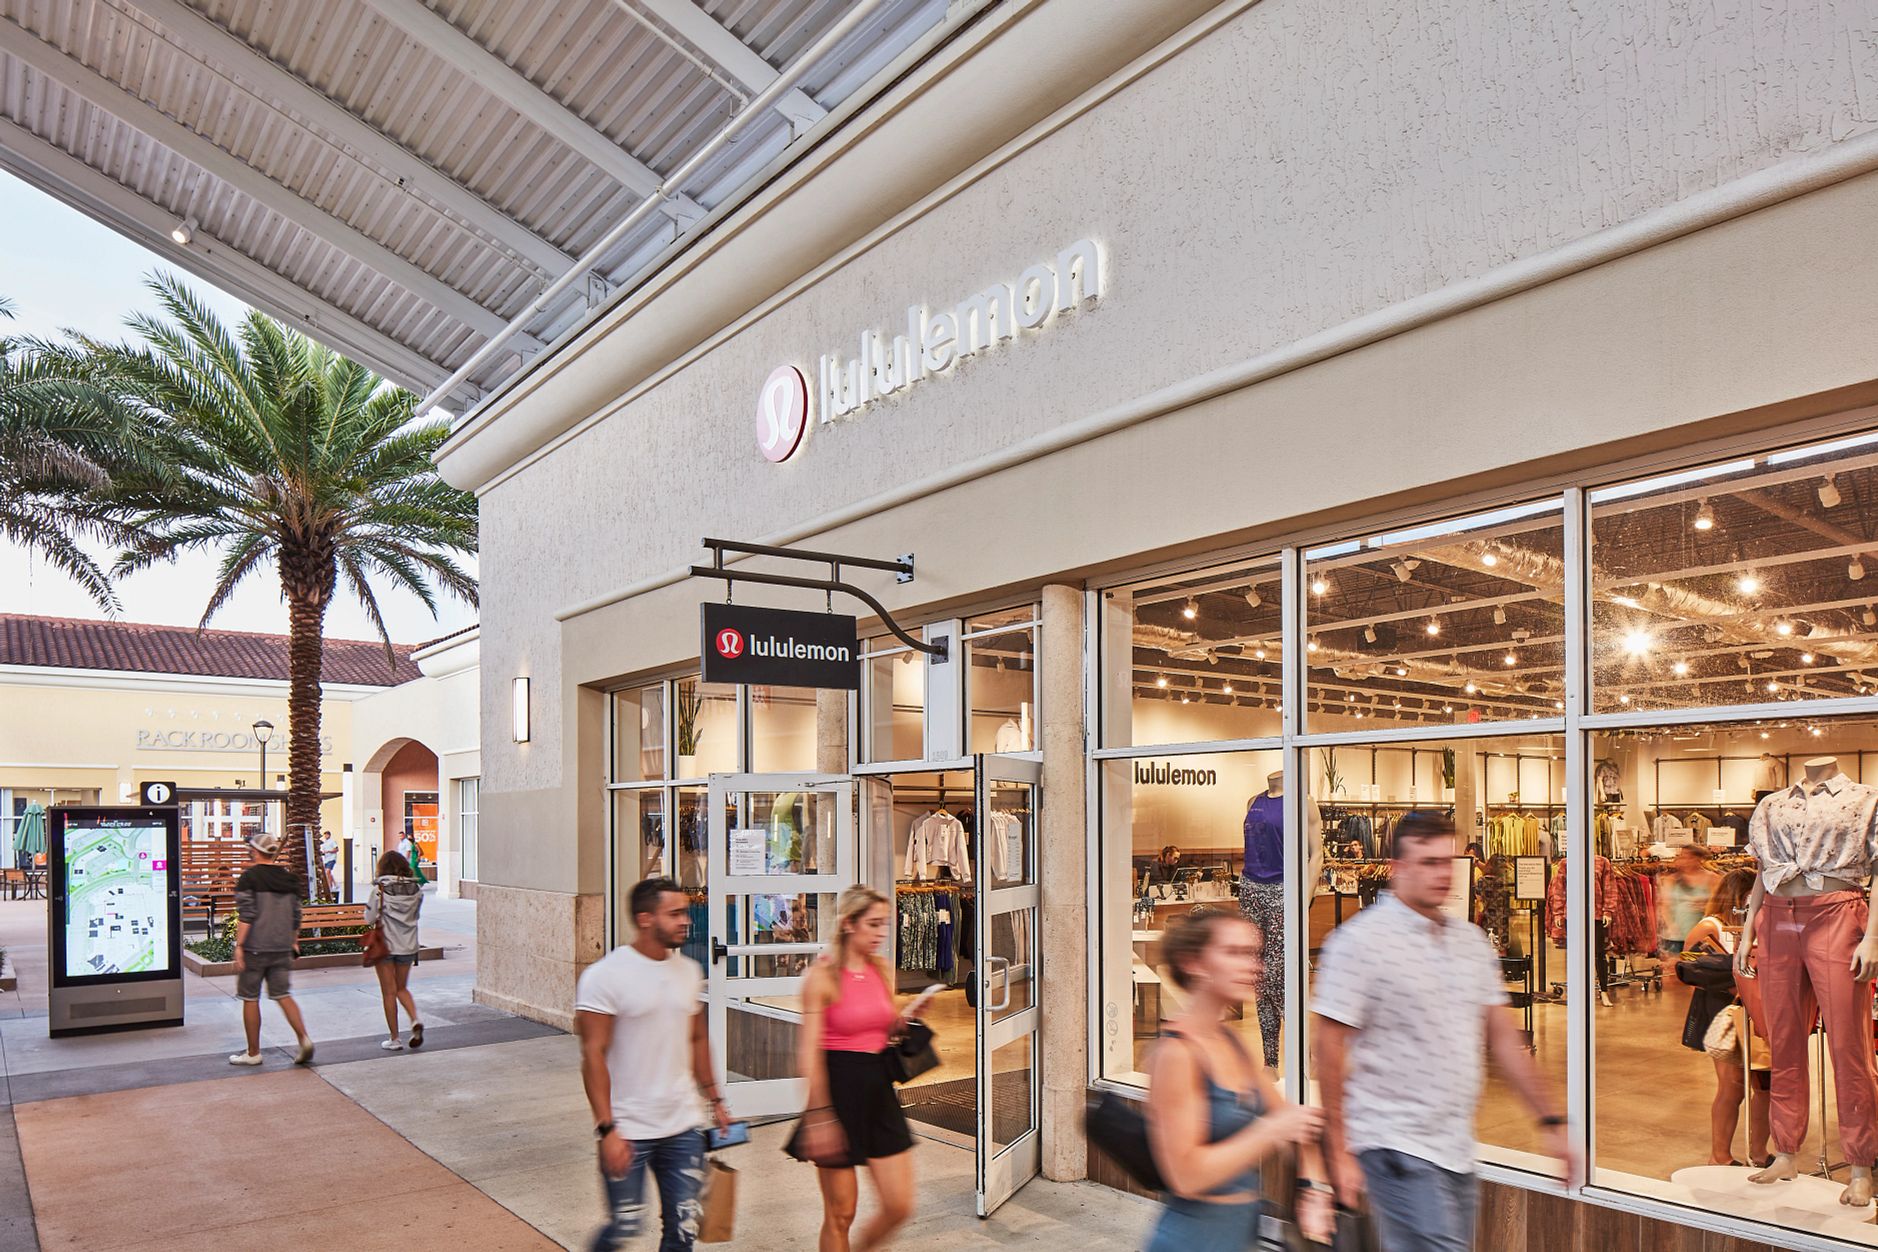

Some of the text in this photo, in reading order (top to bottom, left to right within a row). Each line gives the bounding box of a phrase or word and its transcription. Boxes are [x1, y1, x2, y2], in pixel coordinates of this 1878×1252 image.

[819, 239, 1101, 425] lululemon
[750, 633, 850, 662] lululemon
[137, 730, 196, 748] RACK
[270, 734, 333, 752] SHS
[1134, 761, 1217, 786] lululemon
